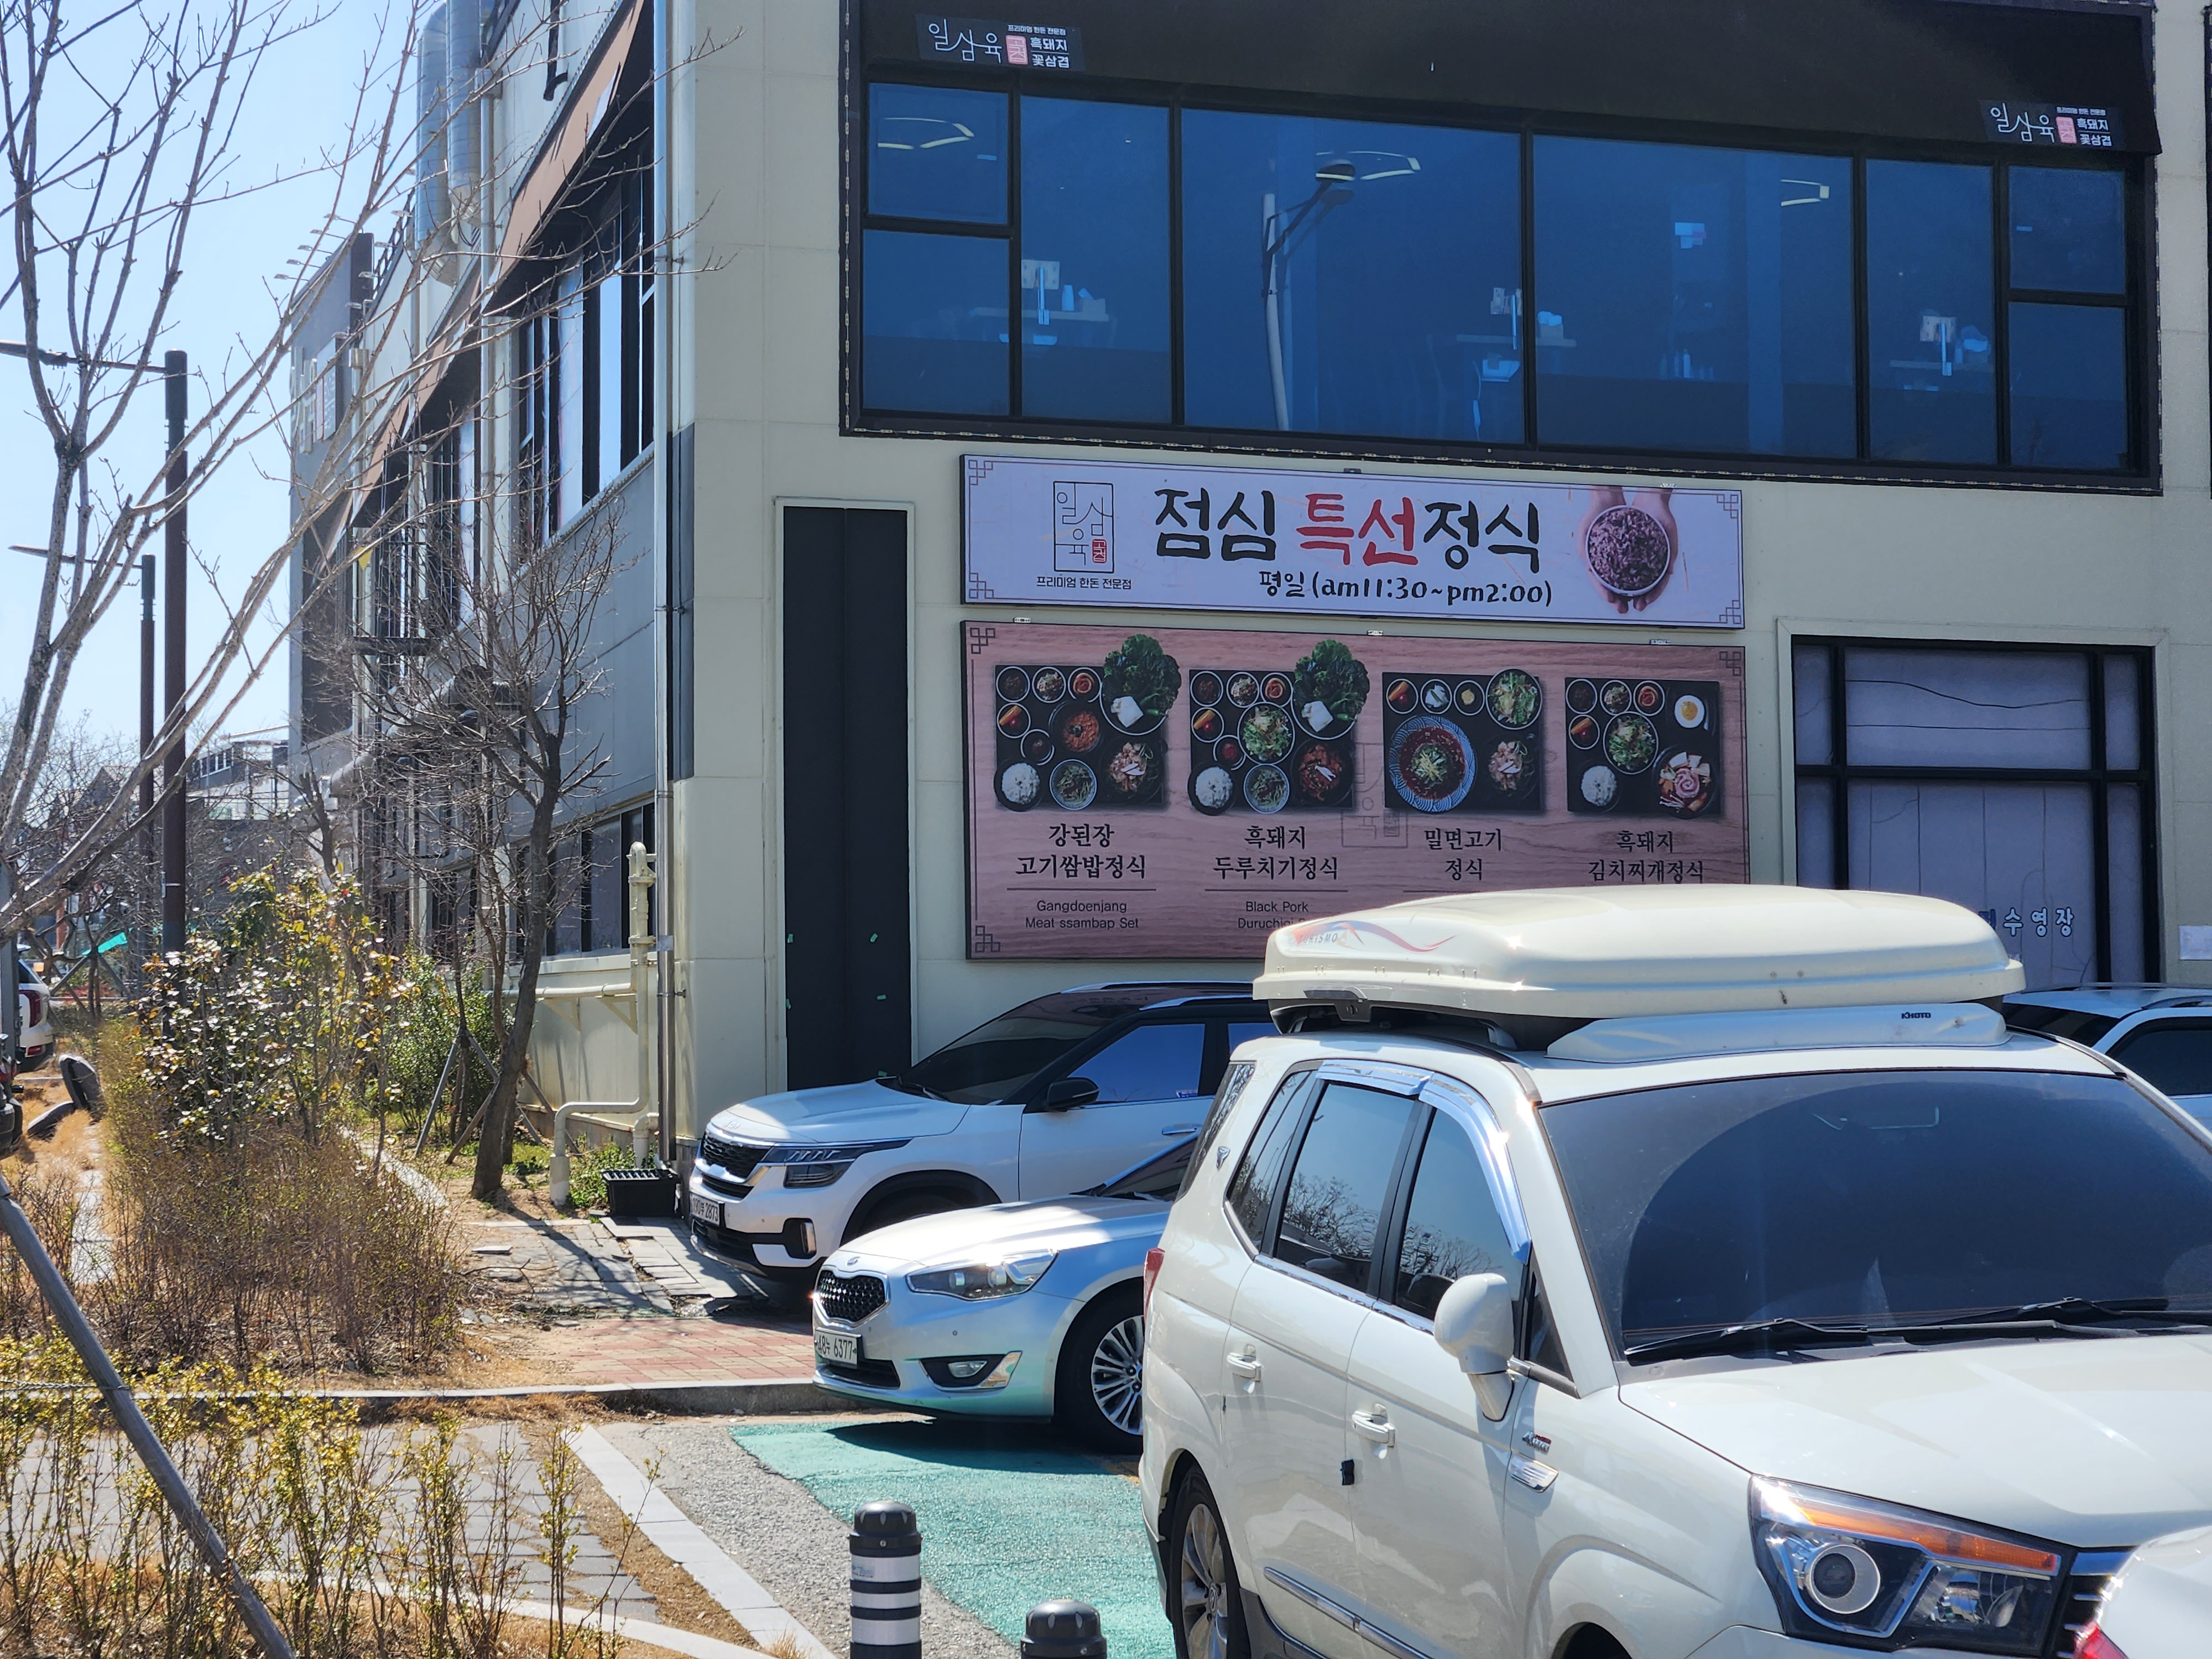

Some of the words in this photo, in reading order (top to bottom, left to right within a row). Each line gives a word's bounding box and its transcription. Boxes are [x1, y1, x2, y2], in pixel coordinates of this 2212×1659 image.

[928, 18, 1002, 64] 일삼육
[1030, 37, 1067, 51] 흑돼지
[1032, 54, 1070, 69] 꽃삼겹
[1991, 103, 2054, 143] 일삼육
[2077, 118, 2108, 131] 흑돼지
[2080, 134, 2111, 147] 꽃삼겹
[1155, 487, 1276, 561] 점심
[1036, 576, 1076, 588] 프리미엄
[1079, 577, 1099, 588] 한돈
[1102, 578, 1132, 589] 전문점
[1048, 823, 1115, 847] 강된장
[1244, 826, 1305, 849] 흑돼지
[1424, 828, 1502, 852] 밀면고기
[1616, 830, 1673, 853] 흑돼지
[1015, 854, 1145, 879] 고기쌈밥정식
[1213, 856, 1338, 880] 두루치기정식
[1445, 858, 1483, 881] 정식
[1588, 859, 1704, 884] 김치찌개정식
[1037, 900, 1127, 913] Gangdoenjang
[1246, 901, 1278, 912] Black
[1283, 901, 1308, 912] Pork
[1025, 917, 1055, 928] Meat
[1060, 917, 1115, 930] ssambap
[1119, 917, 1139, 928] Set
[833, 1337, 853, 1360] 6377
